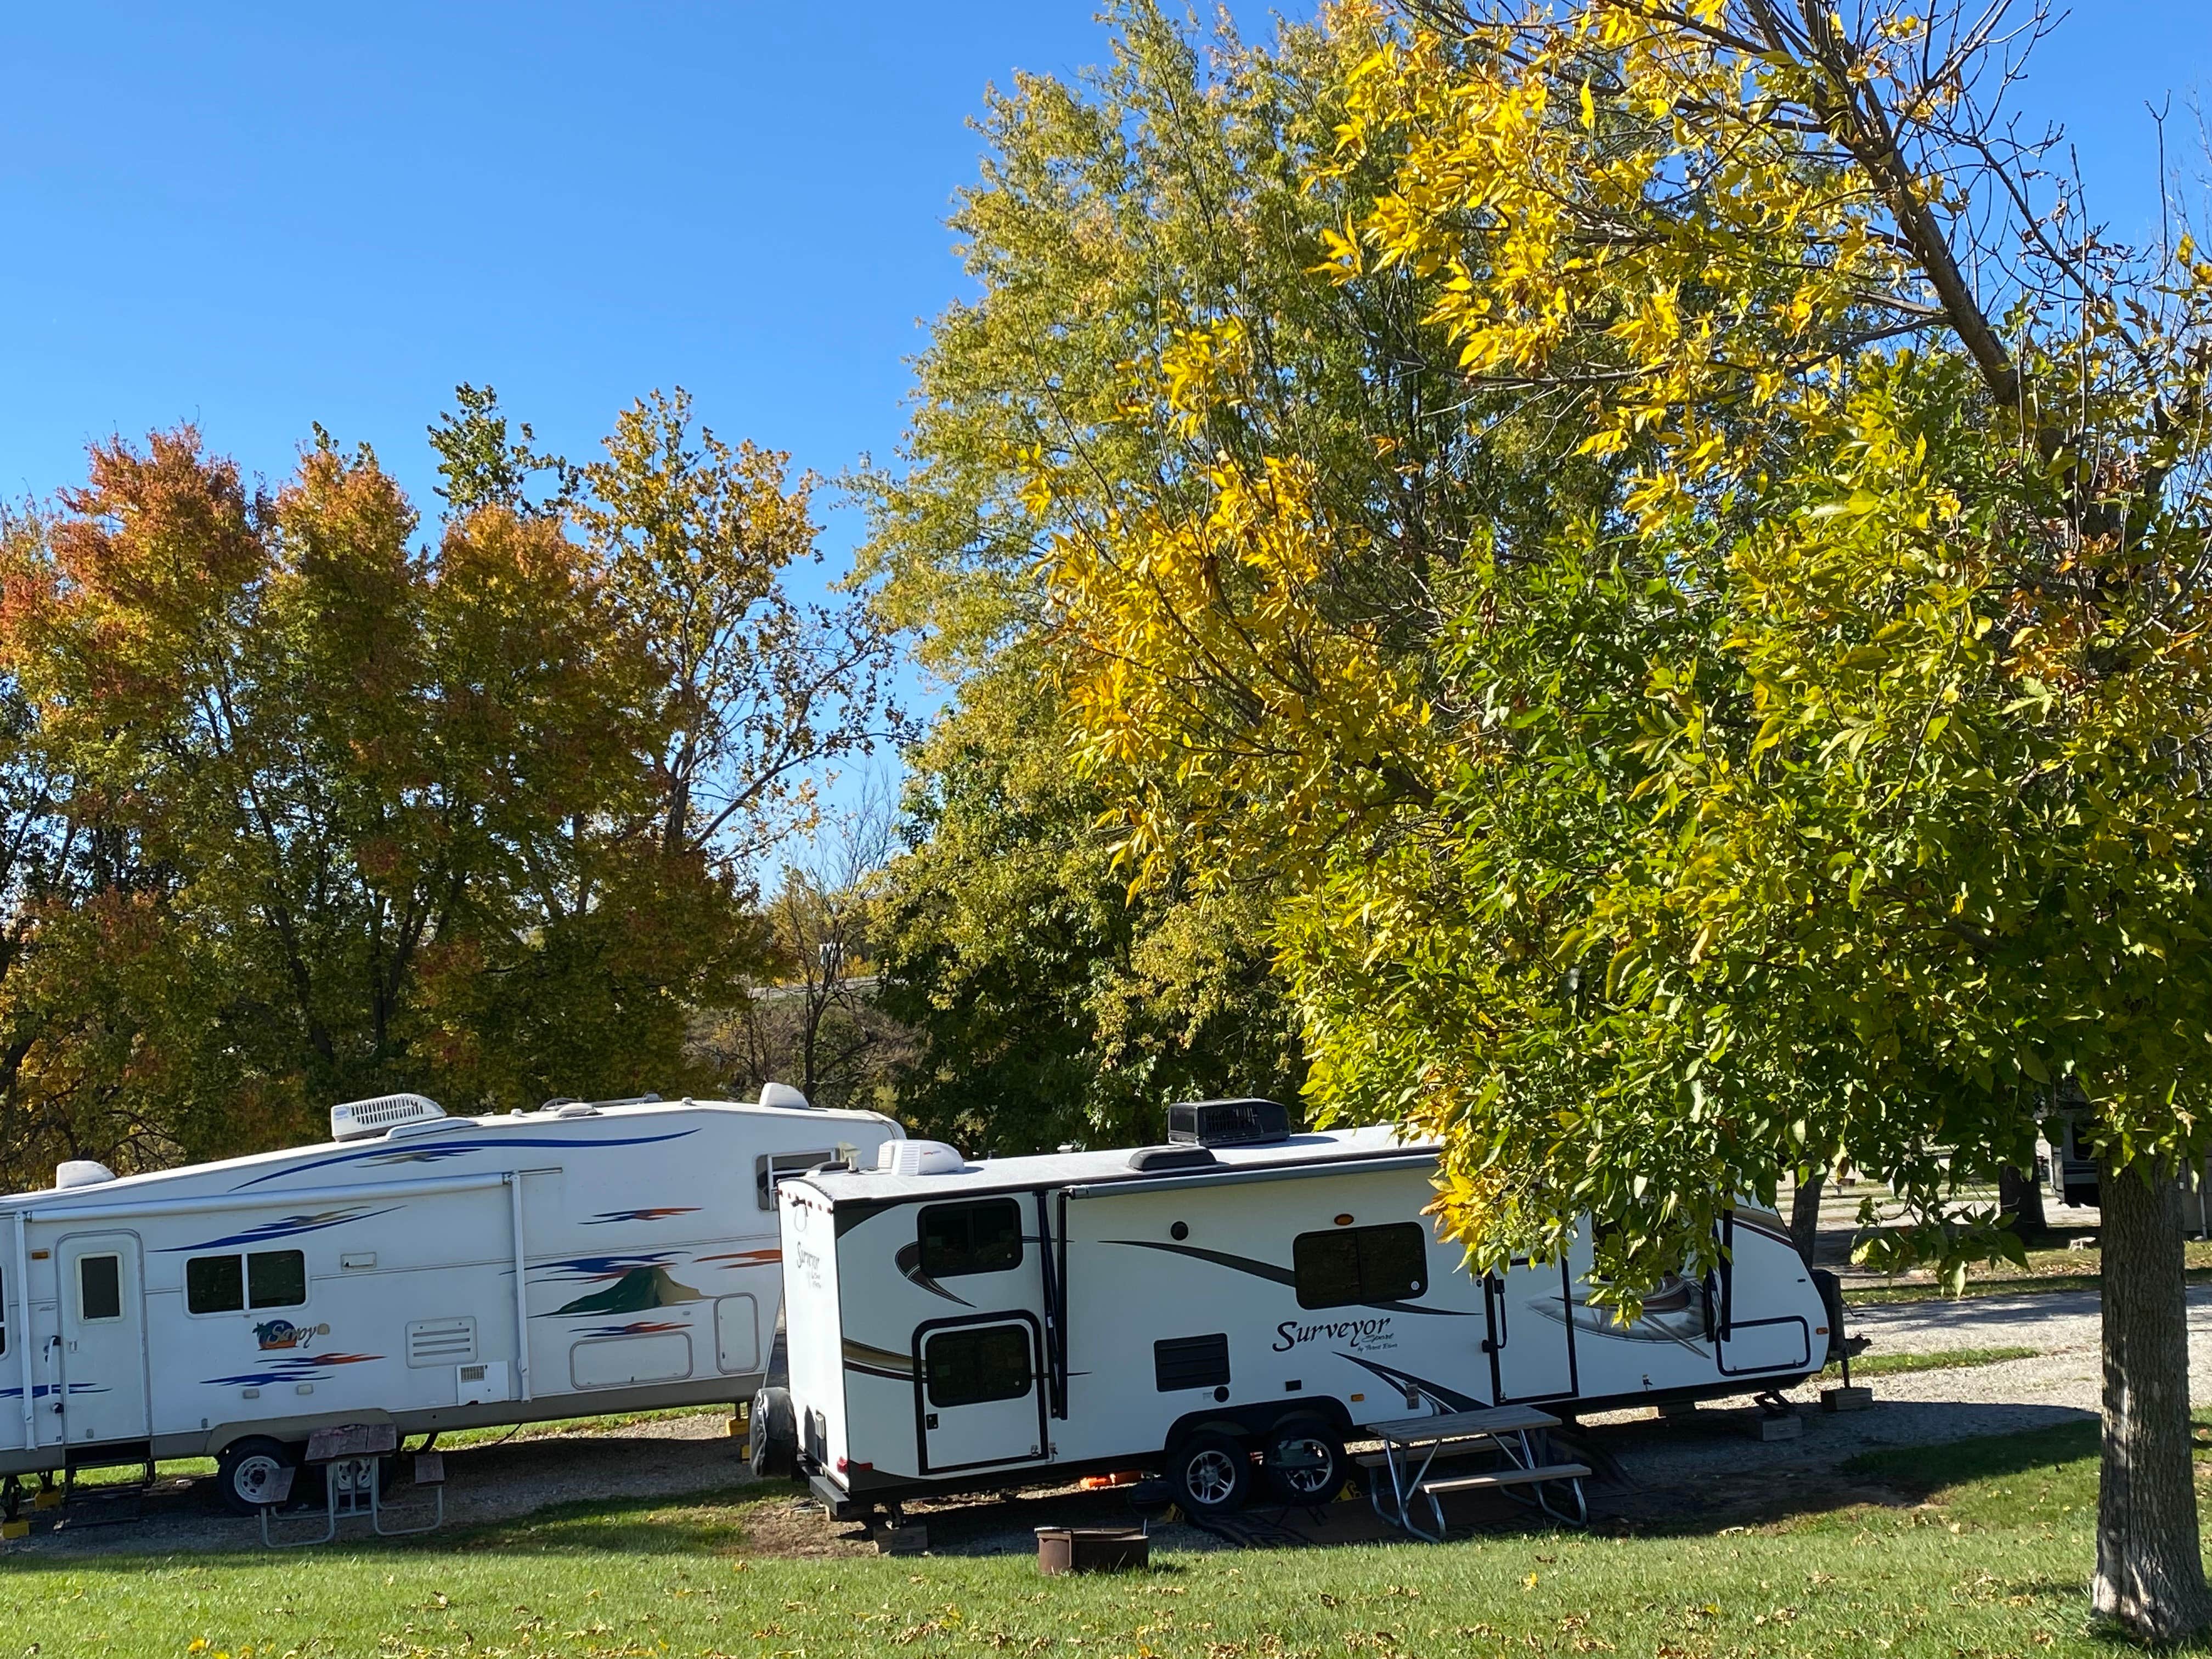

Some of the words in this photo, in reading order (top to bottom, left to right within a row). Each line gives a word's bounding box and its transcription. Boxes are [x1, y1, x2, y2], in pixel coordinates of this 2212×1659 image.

[267, 1324, 317, 1348] Savoy
[1272, 1317, 1391, 1352] Surveyor
[1361, 1333, 1394, 1343] Sport
